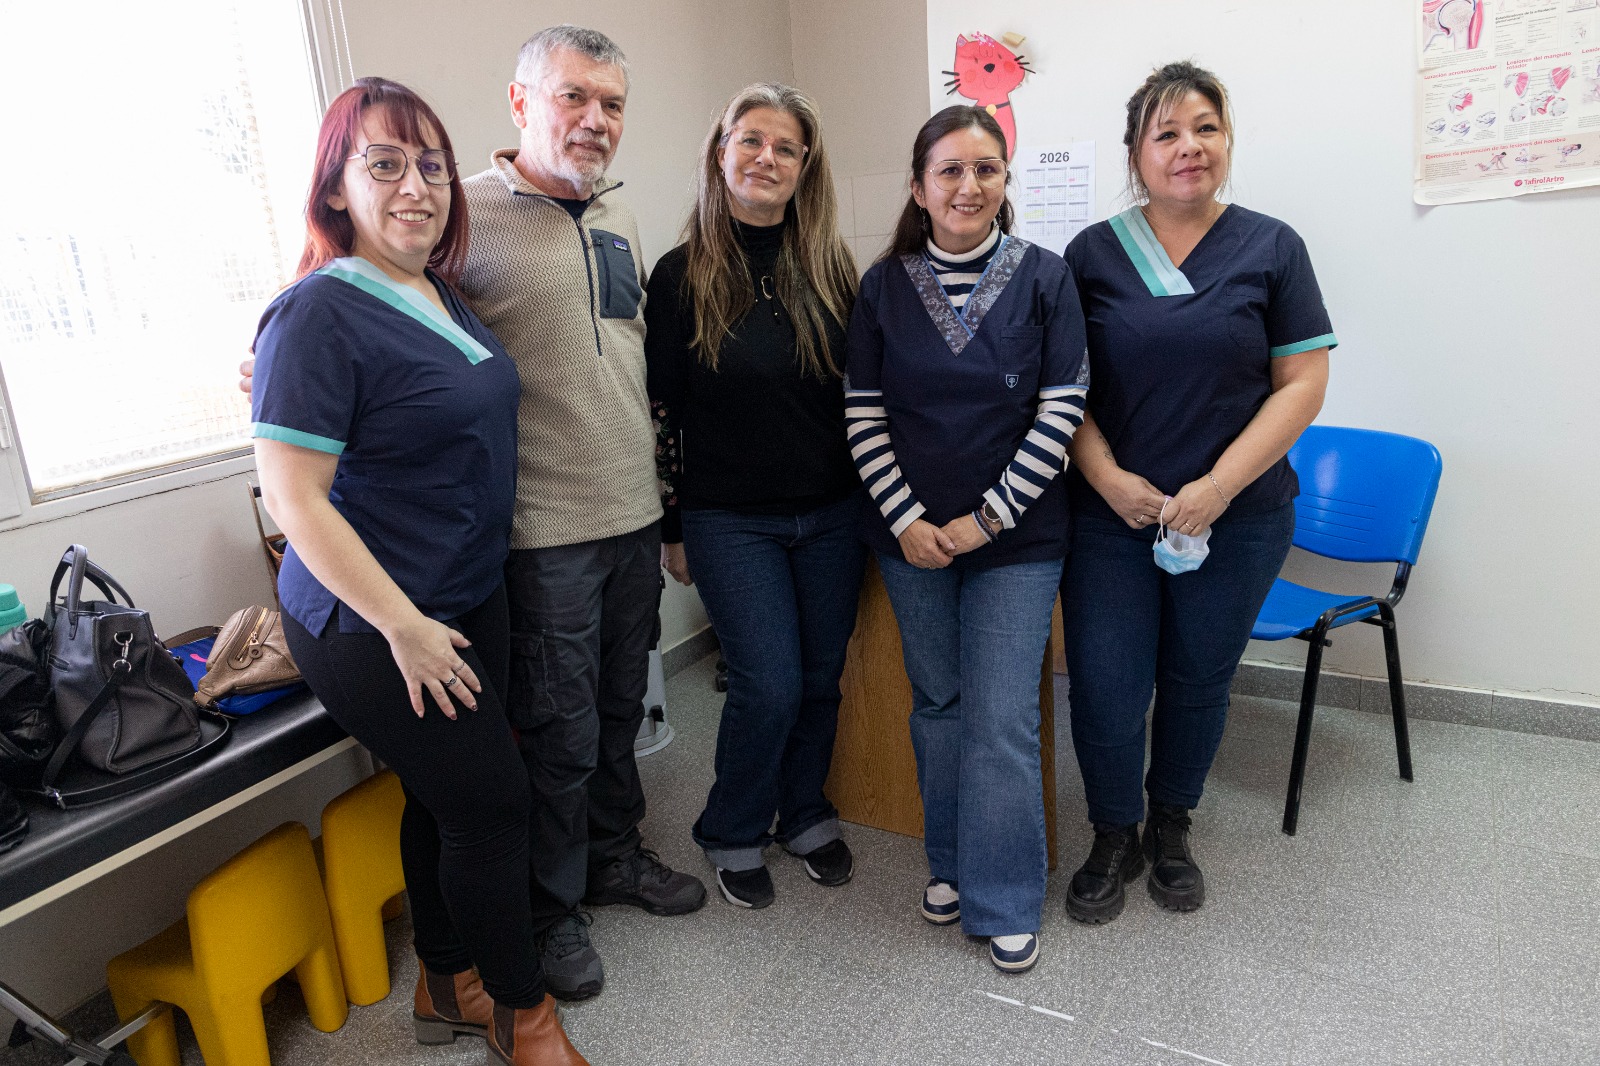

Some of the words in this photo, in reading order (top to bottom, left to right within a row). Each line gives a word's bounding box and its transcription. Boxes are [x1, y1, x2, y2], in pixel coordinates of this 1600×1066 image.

[1506, 57, 1532, 66] Lesiones
[1543, 51, 1572, 60] manguito
[1039, 152, 1070, 163] 2026
